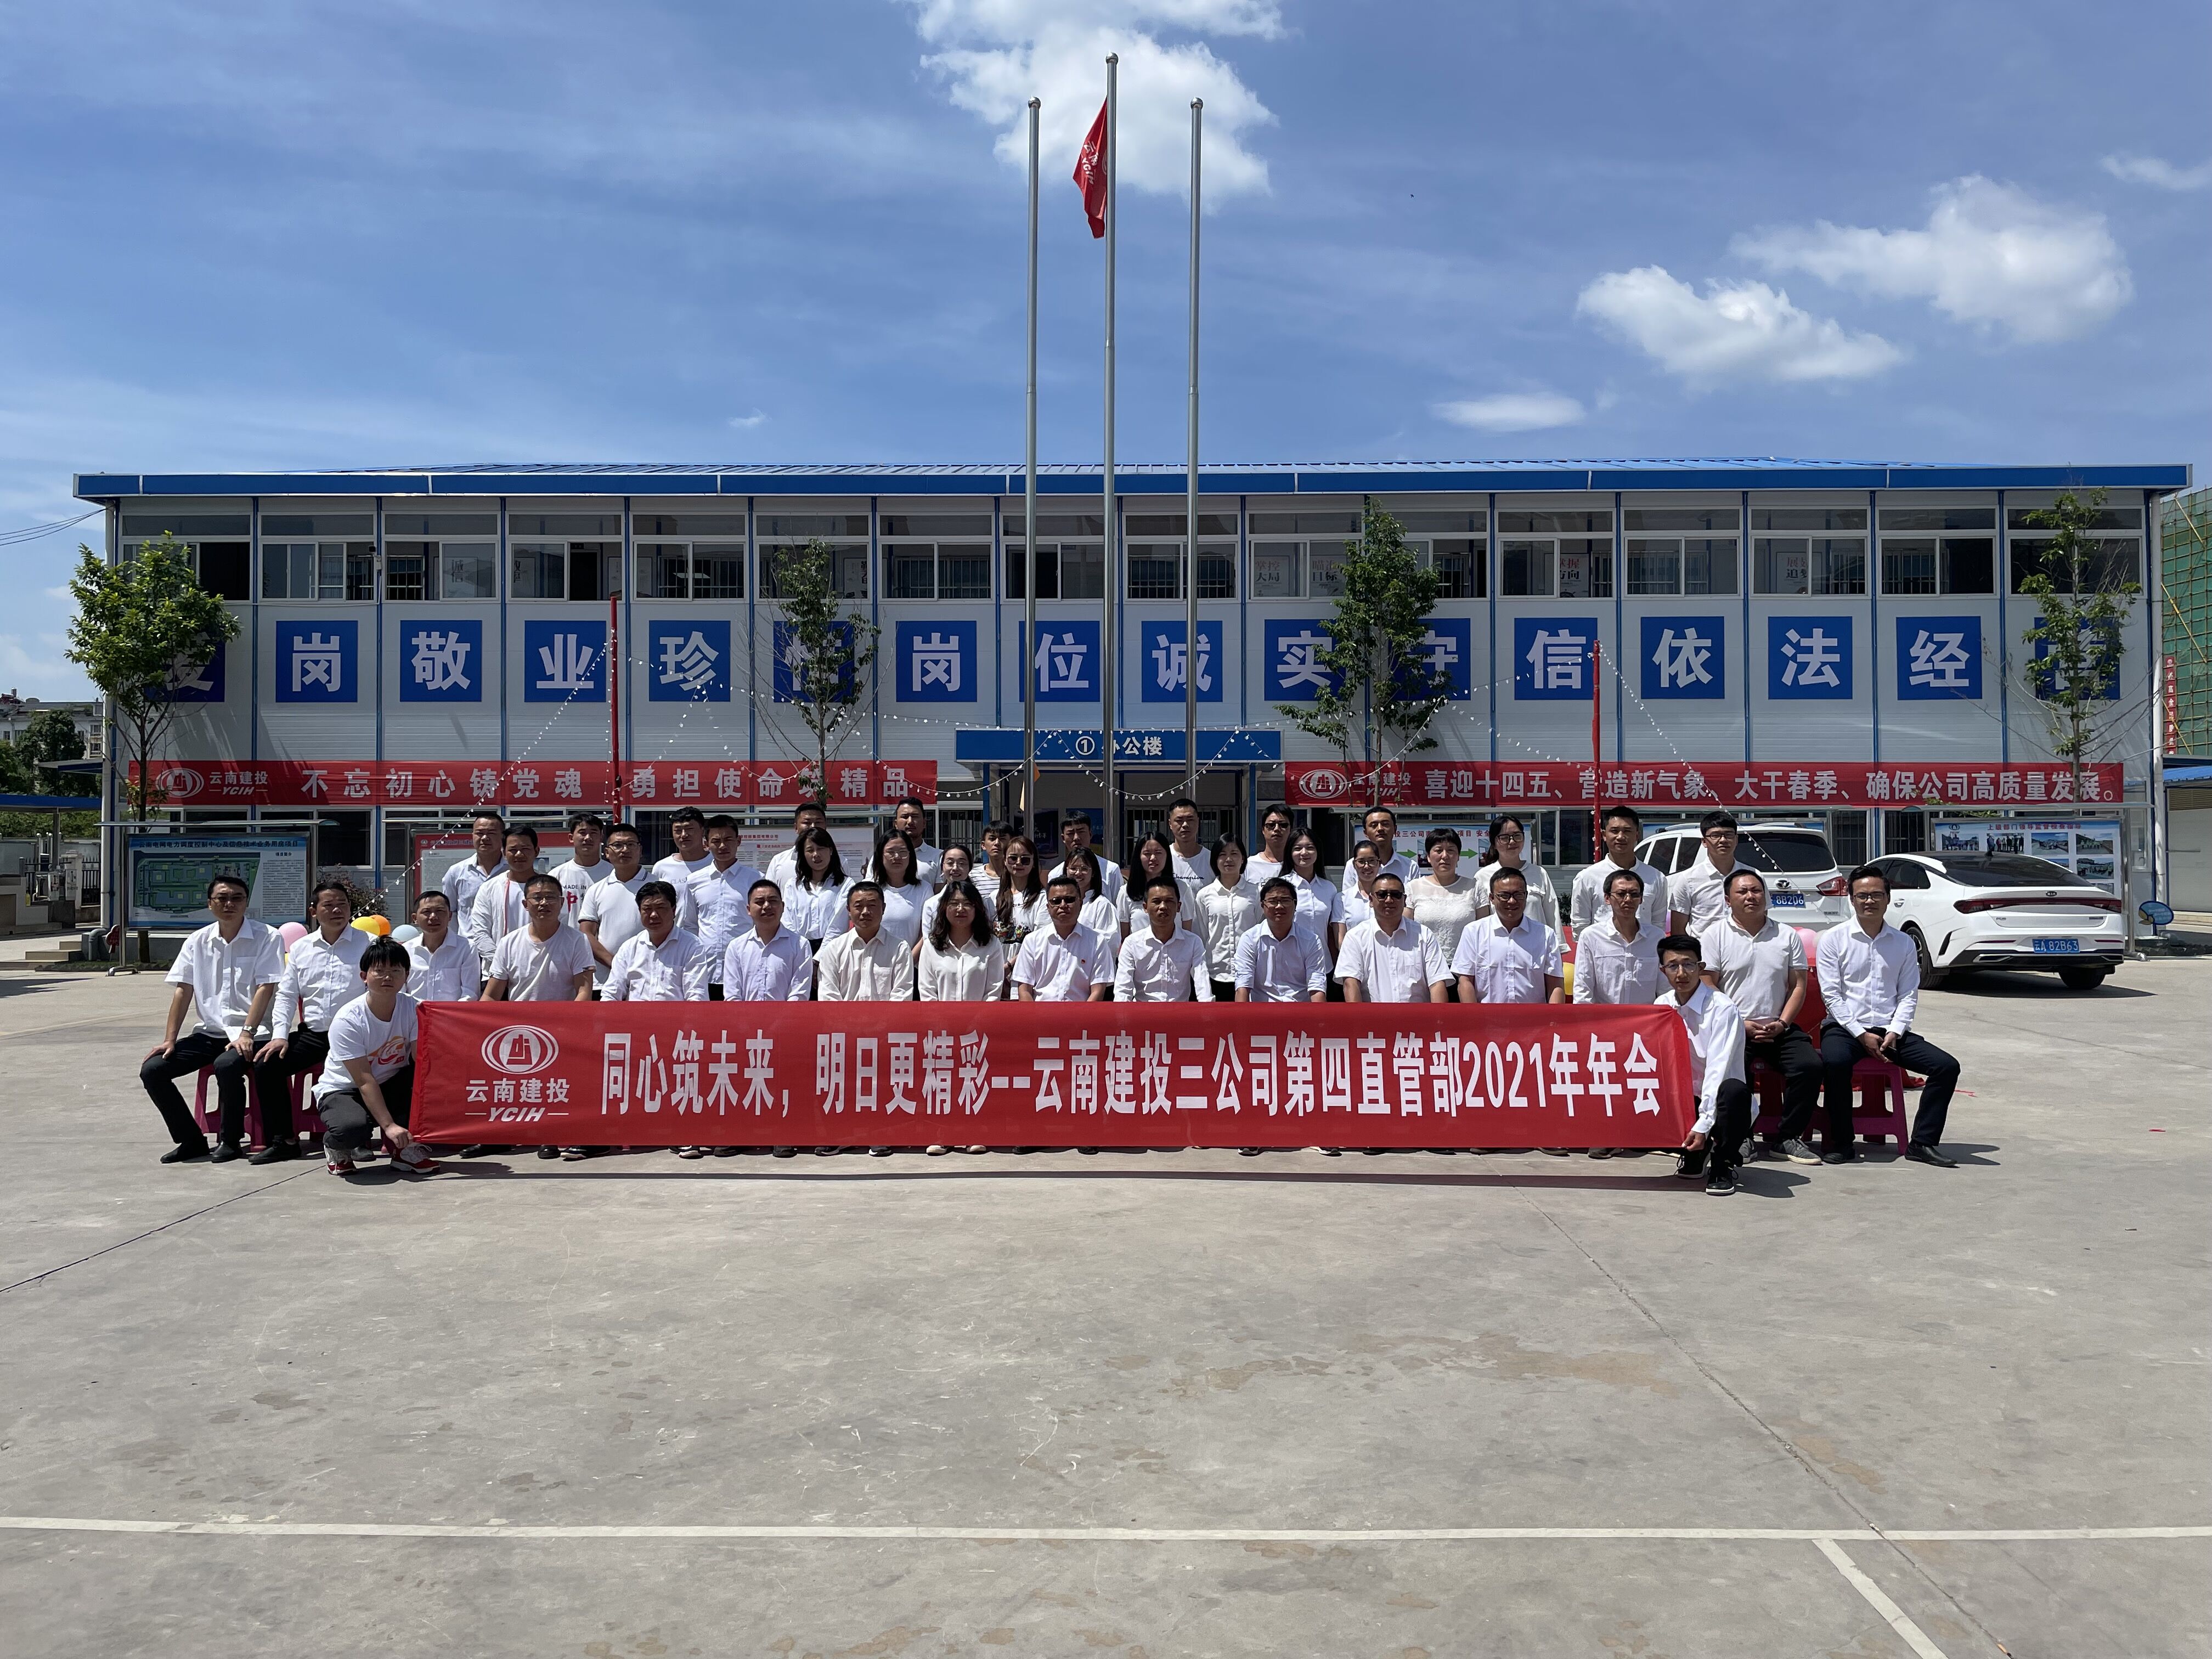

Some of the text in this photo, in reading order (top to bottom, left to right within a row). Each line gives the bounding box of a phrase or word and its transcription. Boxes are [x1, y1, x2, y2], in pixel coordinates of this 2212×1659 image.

[1255, 572, 1280, 582] 大局
[1312, 571, 1338, 582] 目标
[208, 770, 269, 787] 云南建投
[301, 768, 582, 799] 不忘初心铸党魂
[221, 786, 255, 796] YCIH
[466, 1077, 570, 1104] 云南建投
[488, 1107, 546, 1122] YCIH
